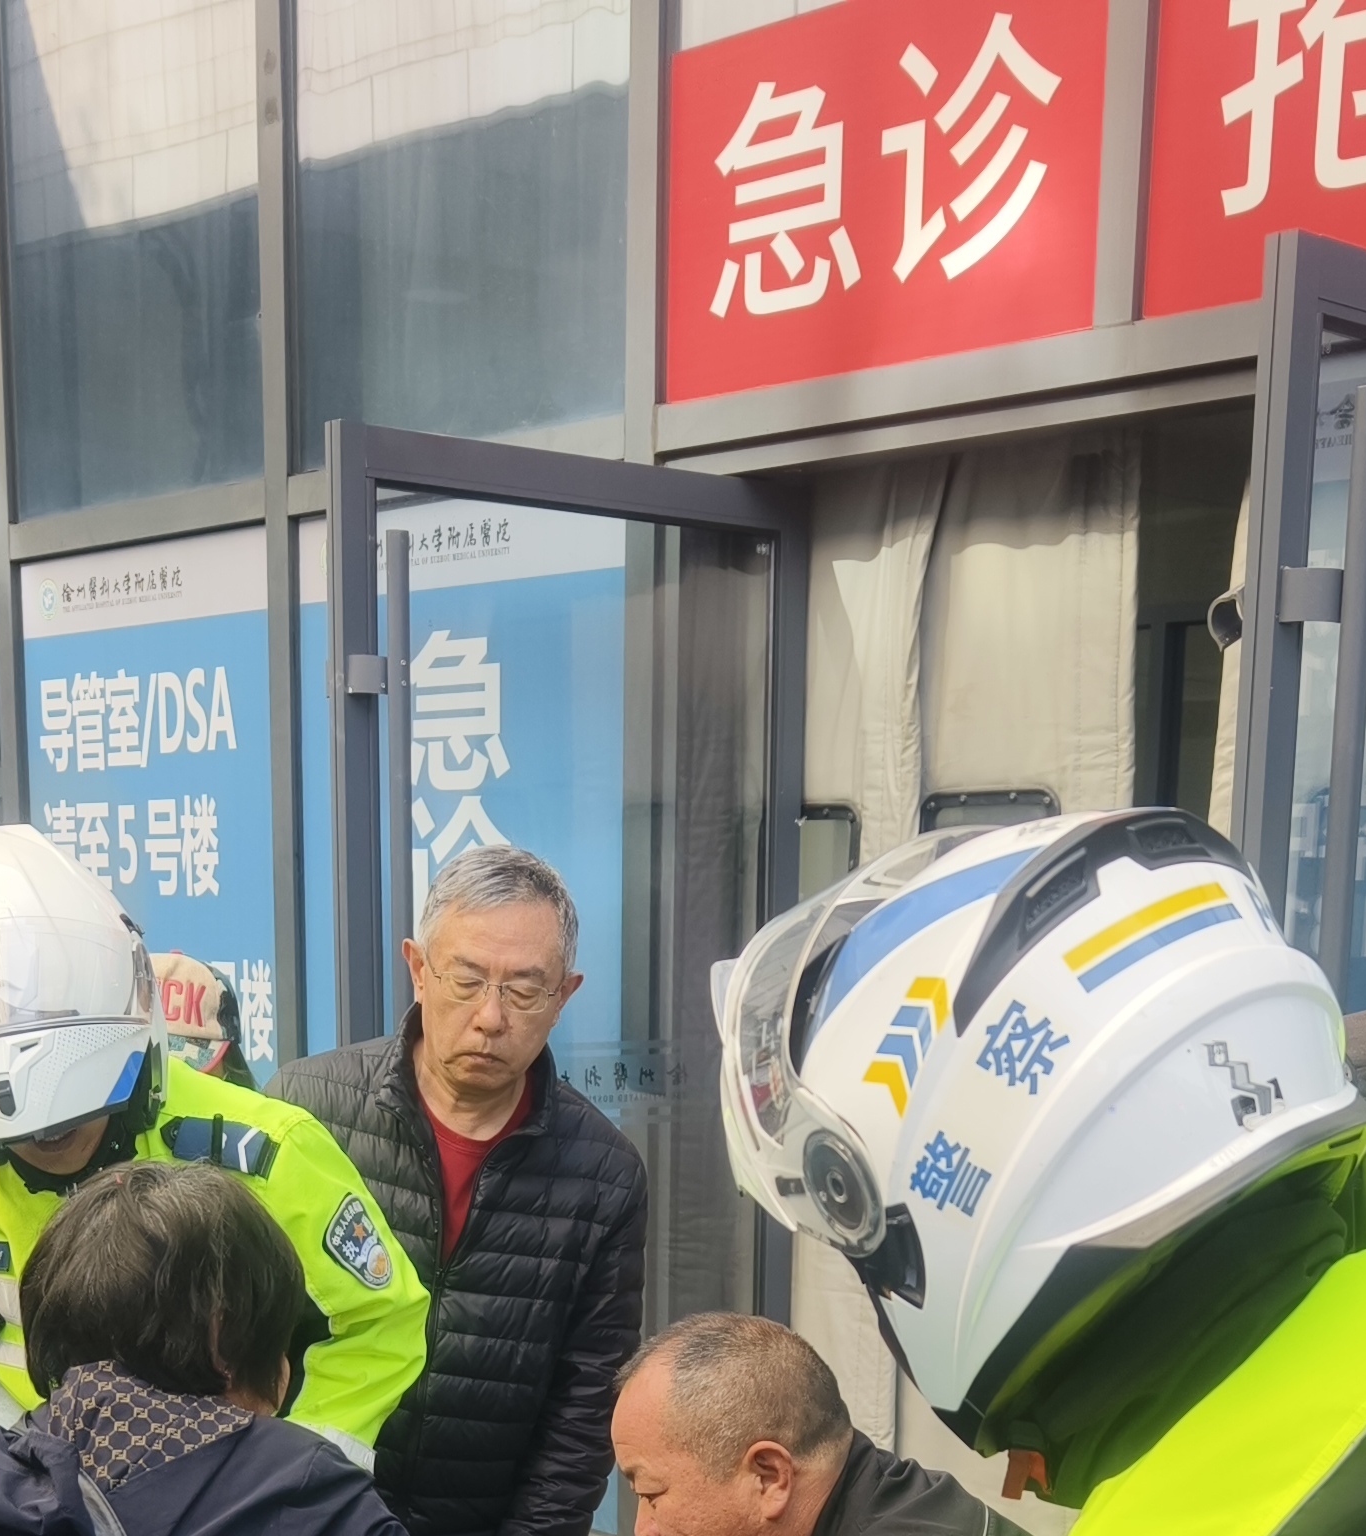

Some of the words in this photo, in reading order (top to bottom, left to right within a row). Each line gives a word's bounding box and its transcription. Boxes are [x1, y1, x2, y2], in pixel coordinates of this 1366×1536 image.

[709, 12, 1062, 319] 急诊
[39, 666, 237, 773] 导管室/DSA
[909, 999, 1071, 1218] 警察
